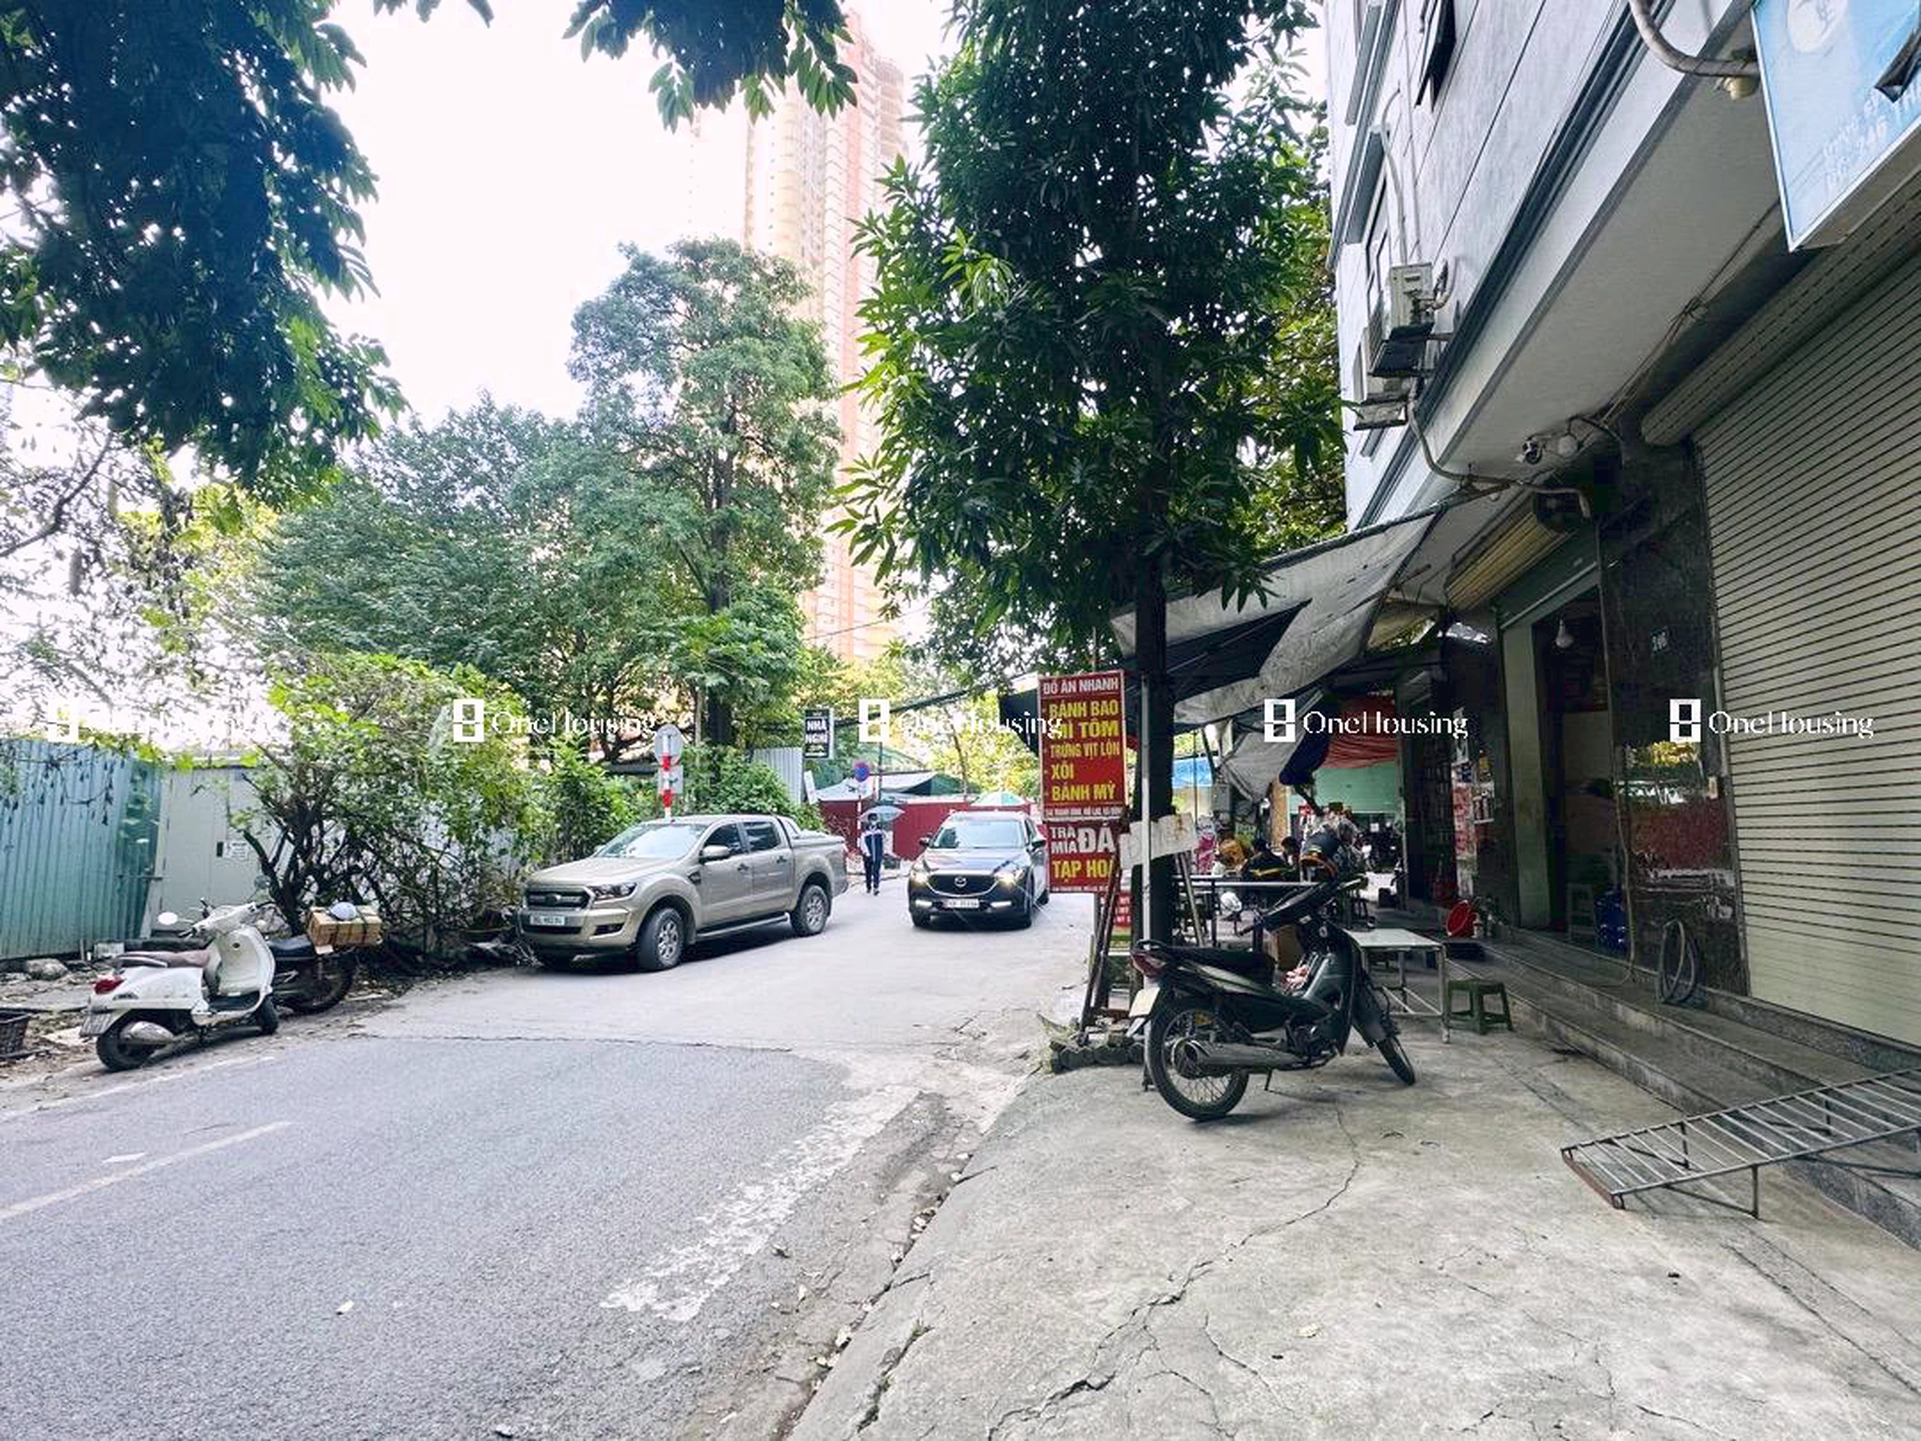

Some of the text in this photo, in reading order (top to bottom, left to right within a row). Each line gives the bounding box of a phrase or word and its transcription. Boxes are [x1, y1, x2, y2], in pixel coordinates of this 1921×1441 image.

[1079, 678, 1118, 691] NHANH
[1049, 700, 1119, 718] BÁNH BAO
[1079, 719, 1119, 738] TÔM
[1051, 760, 1074, 780] XÔI
[1052, 782, 1090, 801] BÁNH
[1050, 822, 1115, 854] TRÀ ĐÁ
[1053, 860, 1113, 883] TẠP HO
